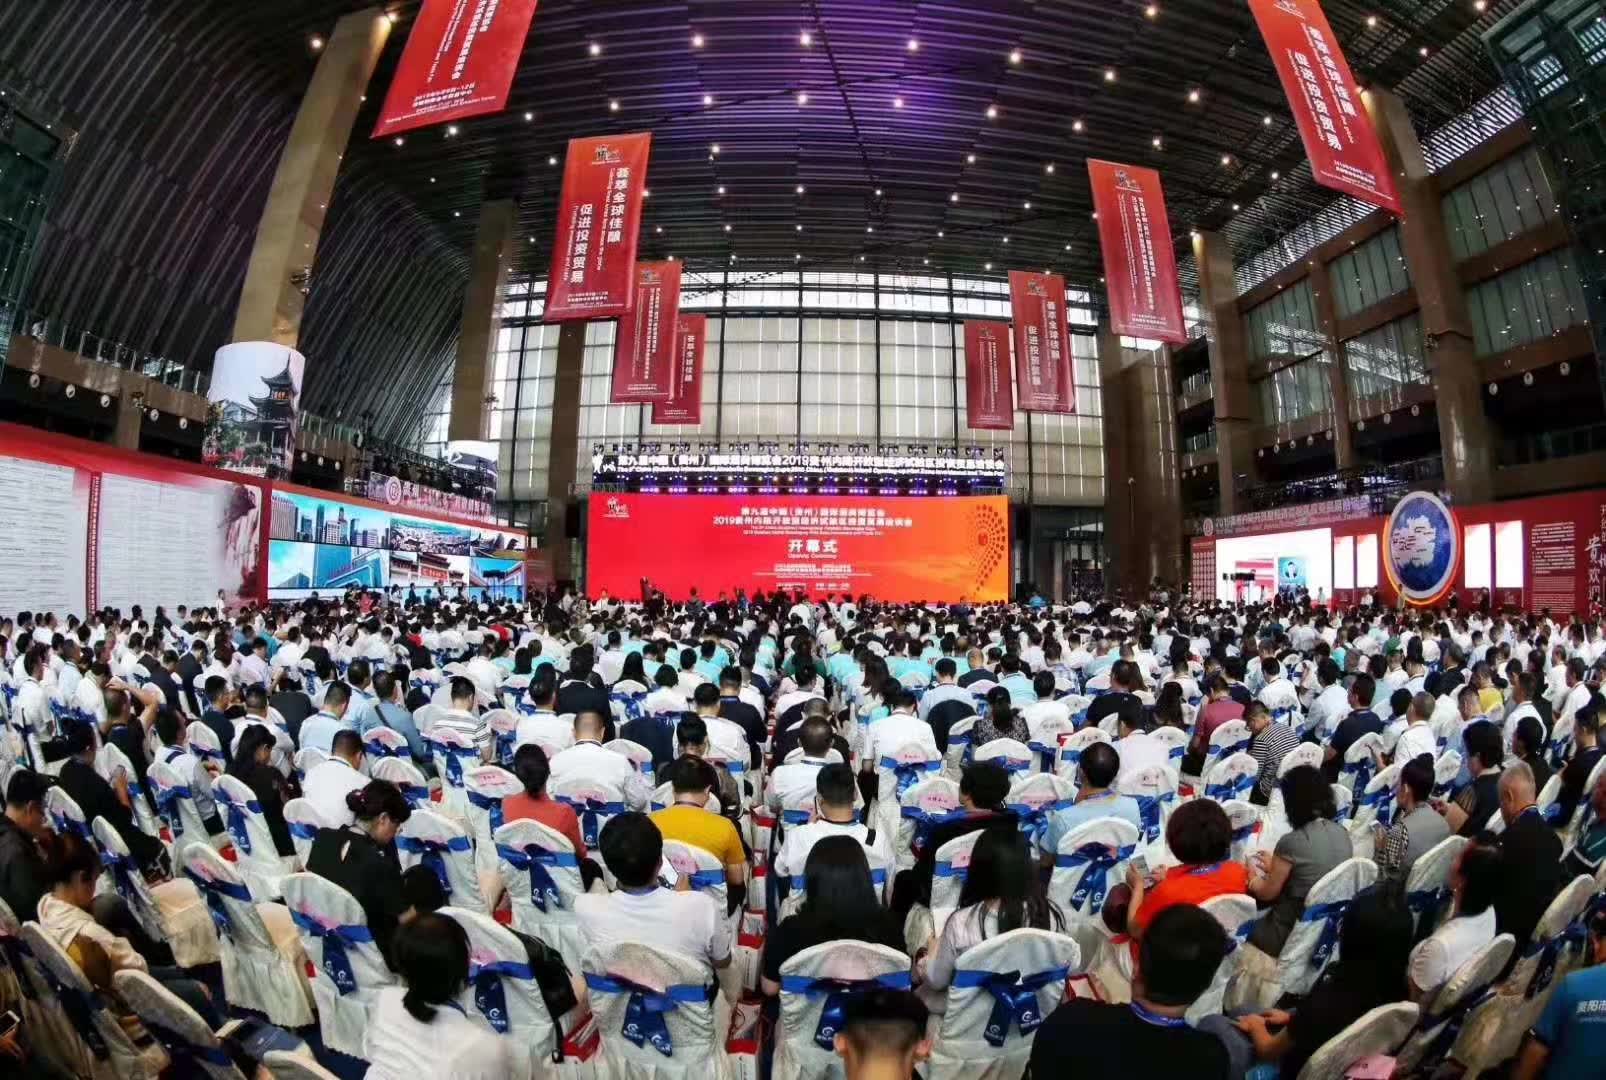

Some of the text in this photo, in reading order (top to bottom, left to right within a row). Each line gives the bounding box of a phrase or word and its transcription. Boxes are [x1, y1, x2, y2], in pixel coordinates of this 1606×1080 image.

[570, 203, 593, 283] 促进投资贸易
[607, 167, 630, 243] 荟萃全球佳酿
[788, 539, 839, 553] 开幕式
